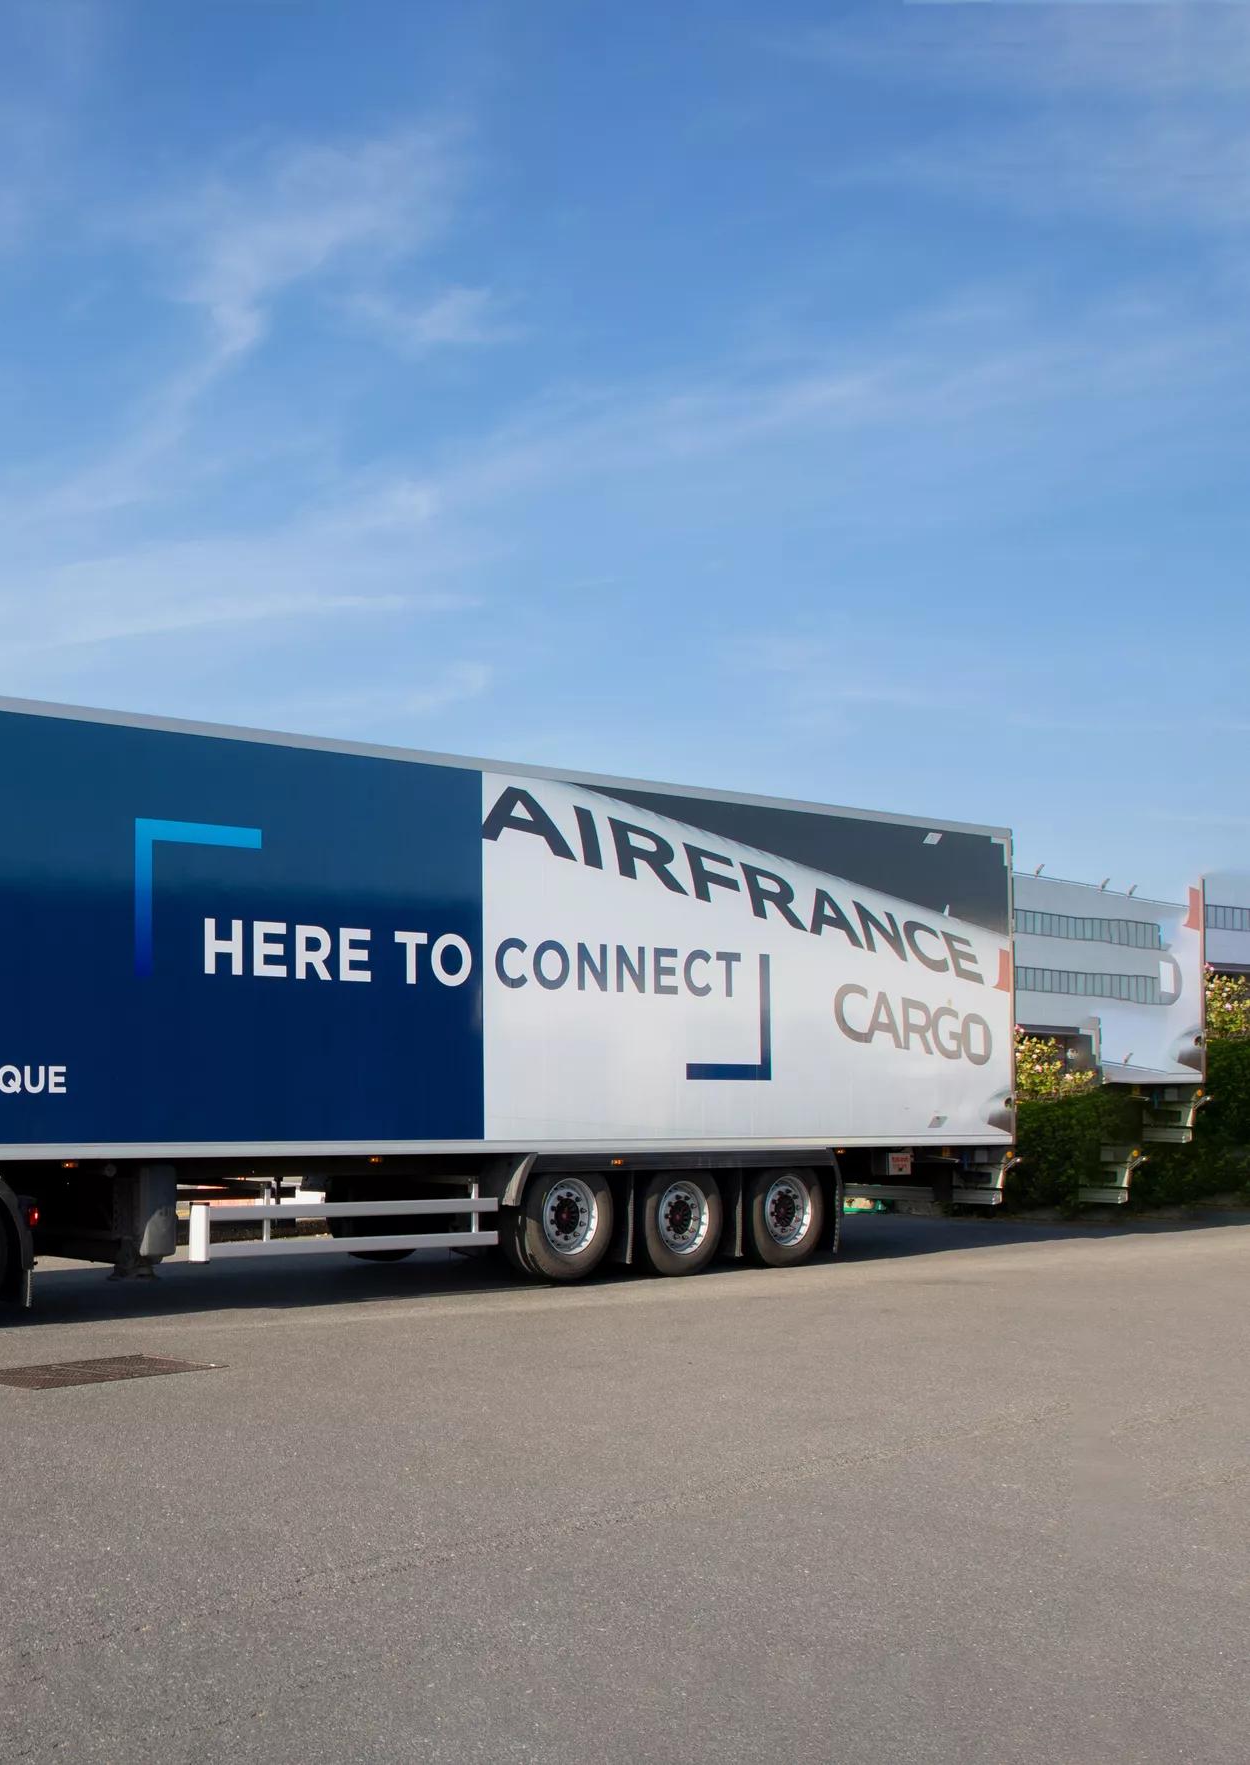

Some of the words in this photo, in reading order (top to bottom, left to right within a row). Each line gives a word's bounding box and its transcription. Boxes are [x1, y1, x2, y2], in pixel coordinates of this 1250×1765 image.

[482, 786, 985, 986] AIRFRANCE
[204, 917, 372, 983] HERE
[394, 930, 472, 987] TO
[494, 937, 742, 998] CONNECT
[834, 983, 993, 1066] CARGO
